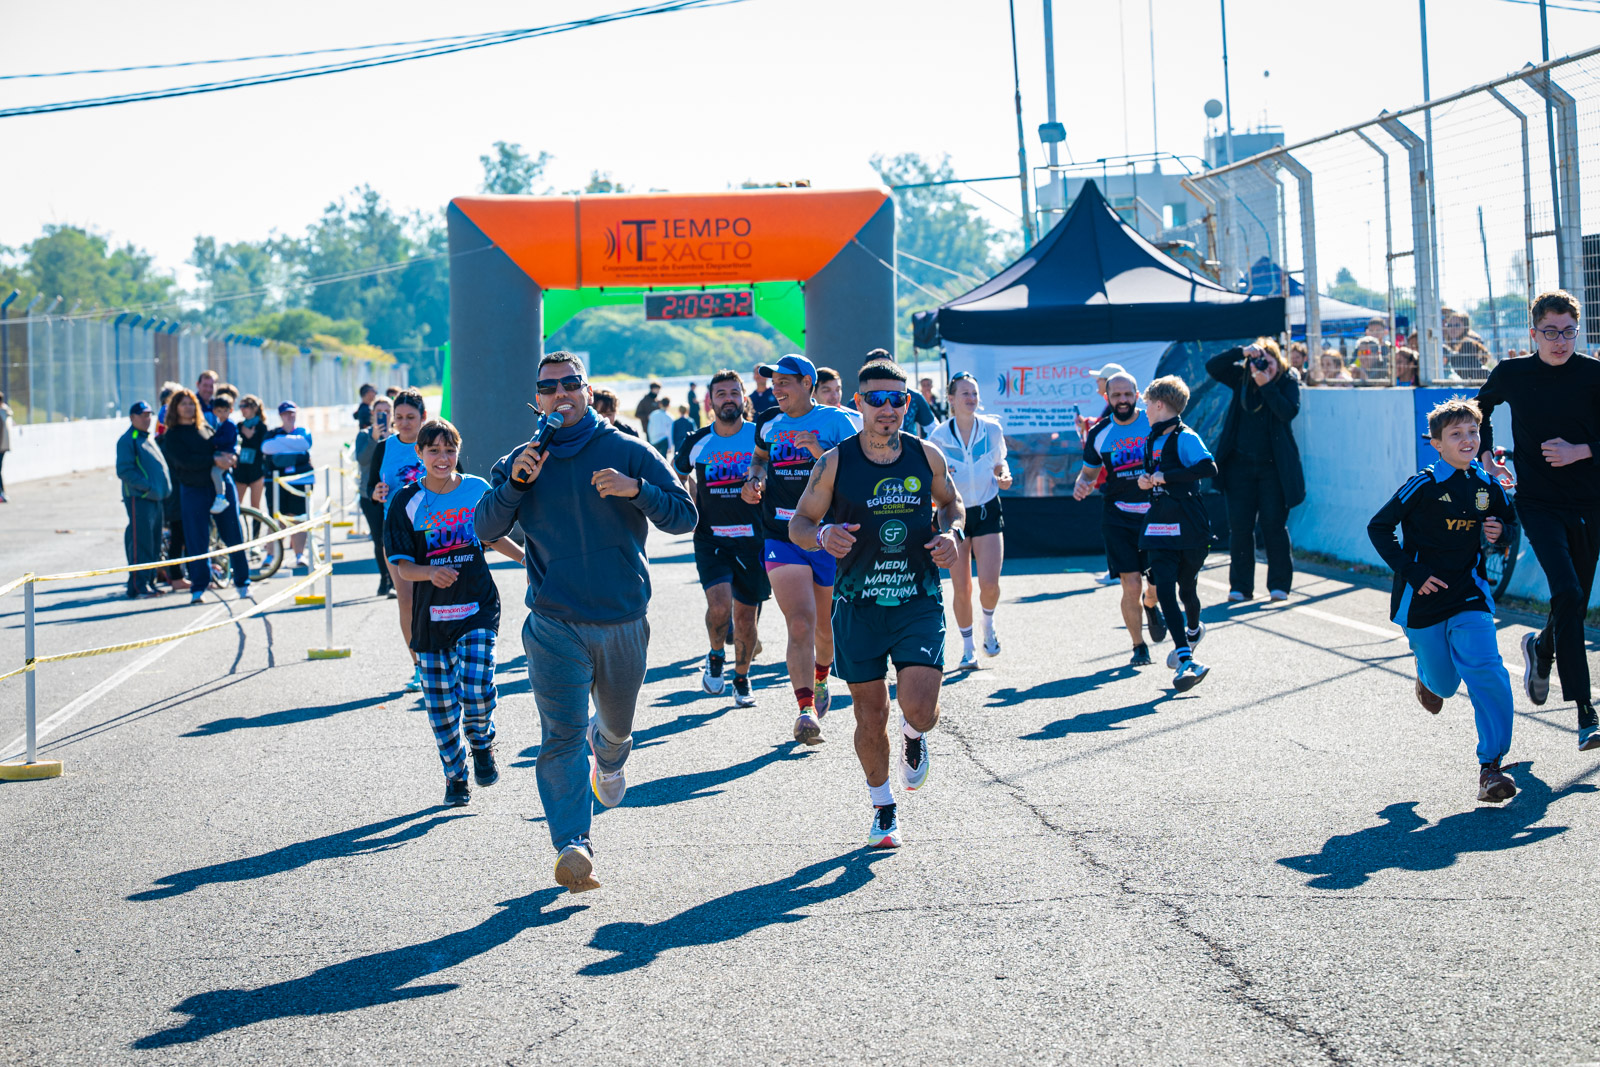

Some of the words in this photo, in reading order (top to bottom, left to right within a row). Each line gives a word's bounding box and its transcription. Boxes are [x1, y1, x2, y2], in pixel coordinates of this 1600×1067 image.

[621, 217, 752, 262] TIEMPO
[644, 225, 753, 262] EXACTO
[662, 292, 752, 319] 2:09:32
[1125, 436, 1148, 449] 50
[908, 478, 918, 490] 3
[866, 495, 921, 508] EGUSQUIZA
[1446, 518, 1477, 531] YPF
[861, 585, 918, 599] NOCTURNA
